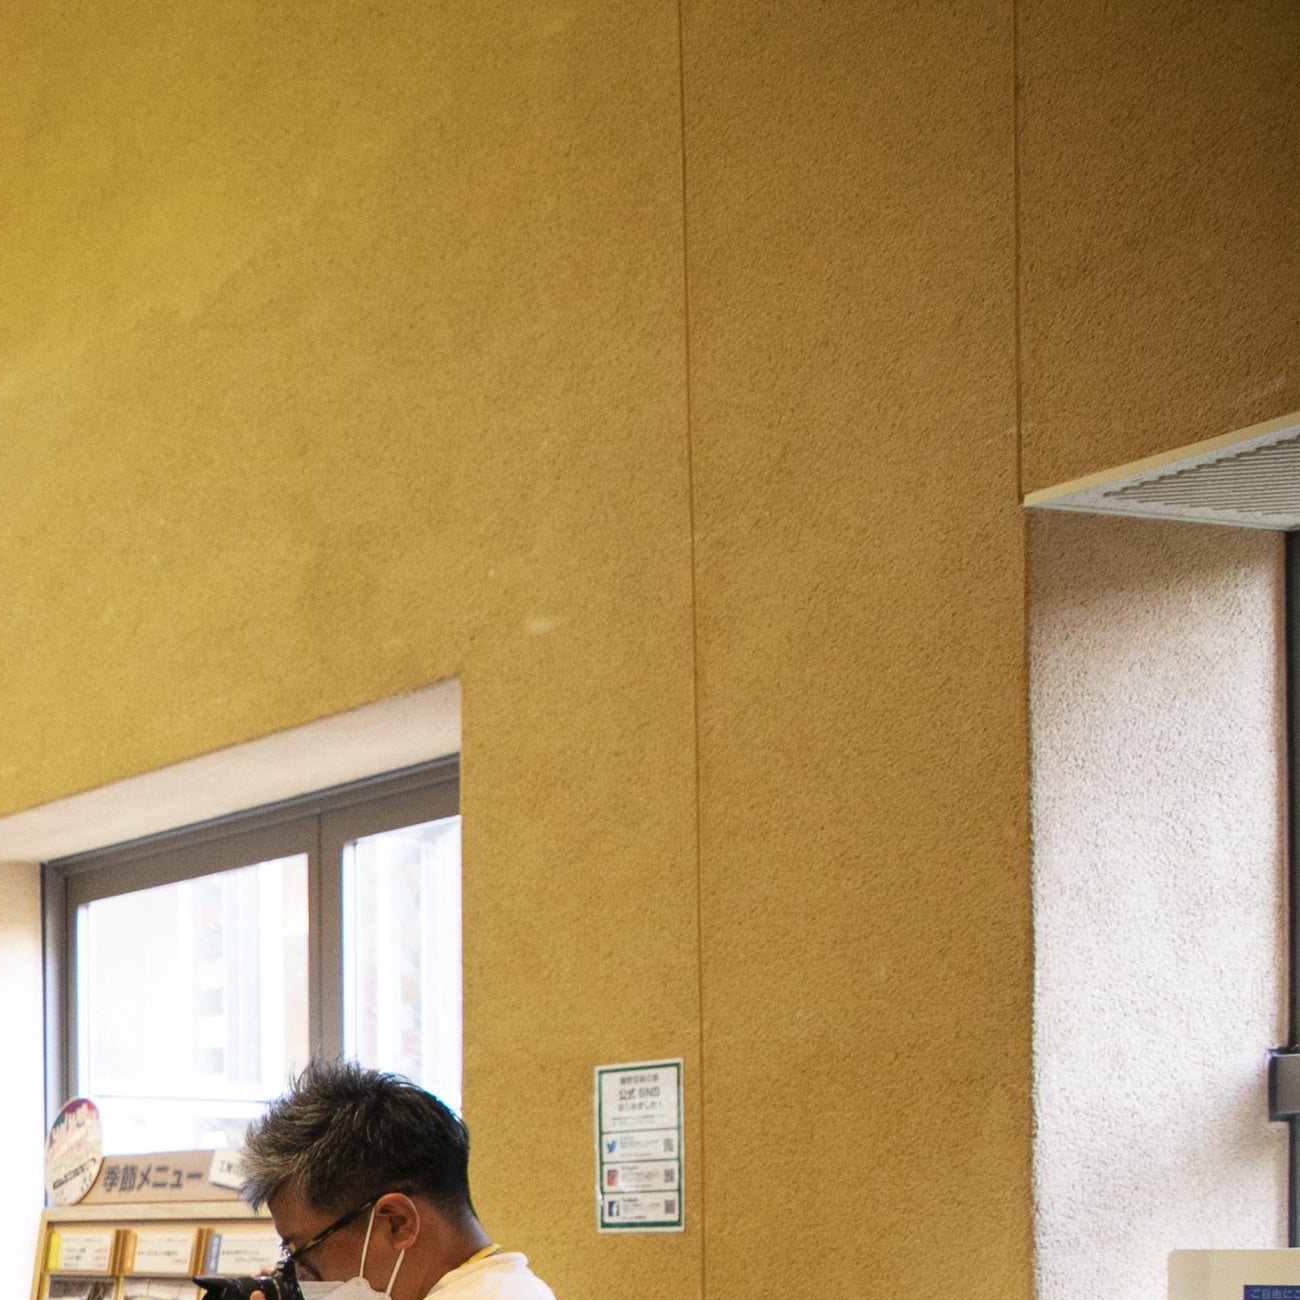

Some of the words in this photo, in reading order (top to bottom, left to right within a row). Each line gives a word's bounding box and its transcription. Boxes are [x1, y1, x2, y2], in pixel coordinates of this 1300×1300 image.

[103, 1164, 203, 1193] 季節メニュー
